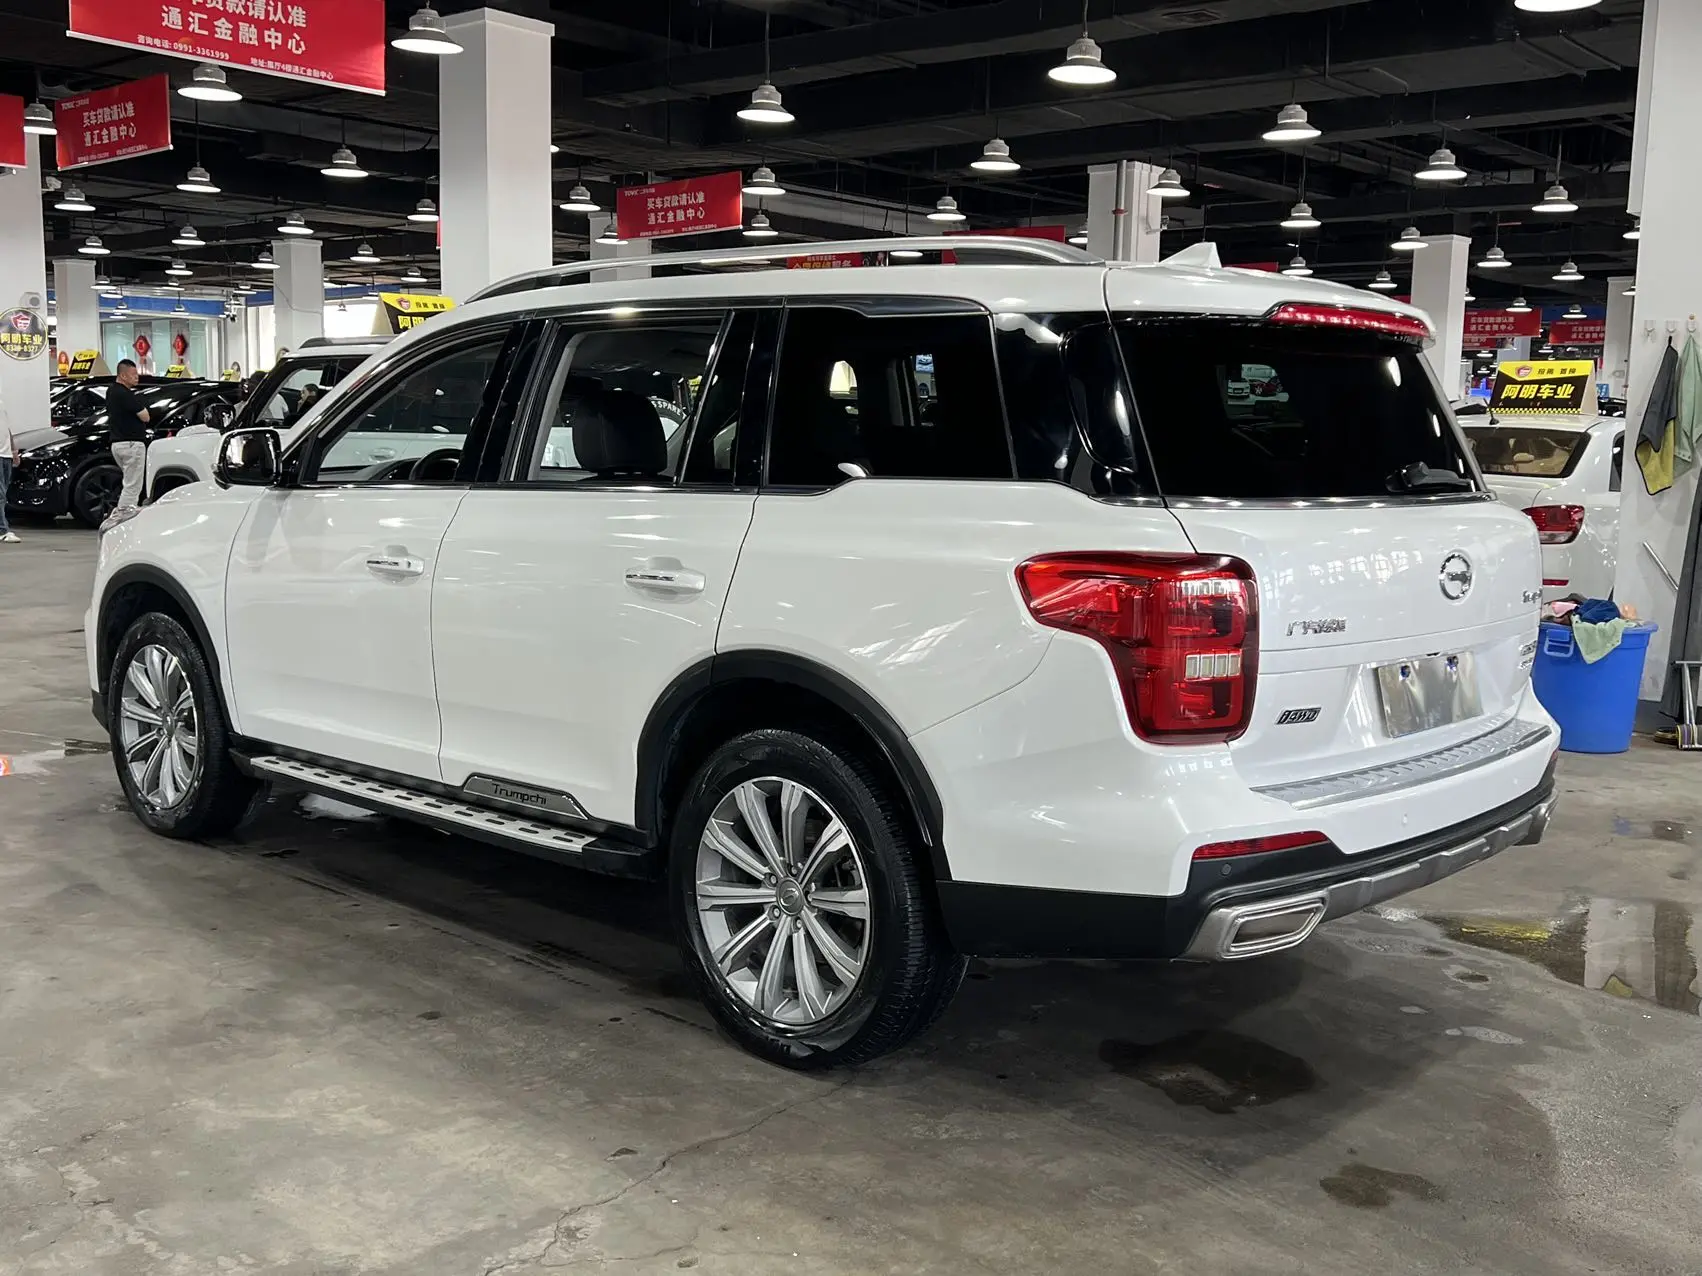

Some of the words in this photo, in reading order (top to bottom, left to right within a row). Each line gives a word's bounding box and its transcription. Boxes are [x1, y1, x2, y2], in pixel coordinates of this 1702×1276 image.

[192, 0, 306, 28] 款请认准
[161, 5, 306, 55] 通汇金融中心
[173, 42, 230, 60] 0991-3361999
[83, 101, 135, 127] 买车贷款请认准
[84, 122, 137, 147] 通汇金融中心
[647, 191, 705, 210] 买车贷款请认准
[648, 207, 705, 225] 通汇金融中心
[0, 333, 43, 345] 阿明车业
[1501, 383, 1575, 399] 阿明车业
[492, 783, 547, 804] Trumpchi
